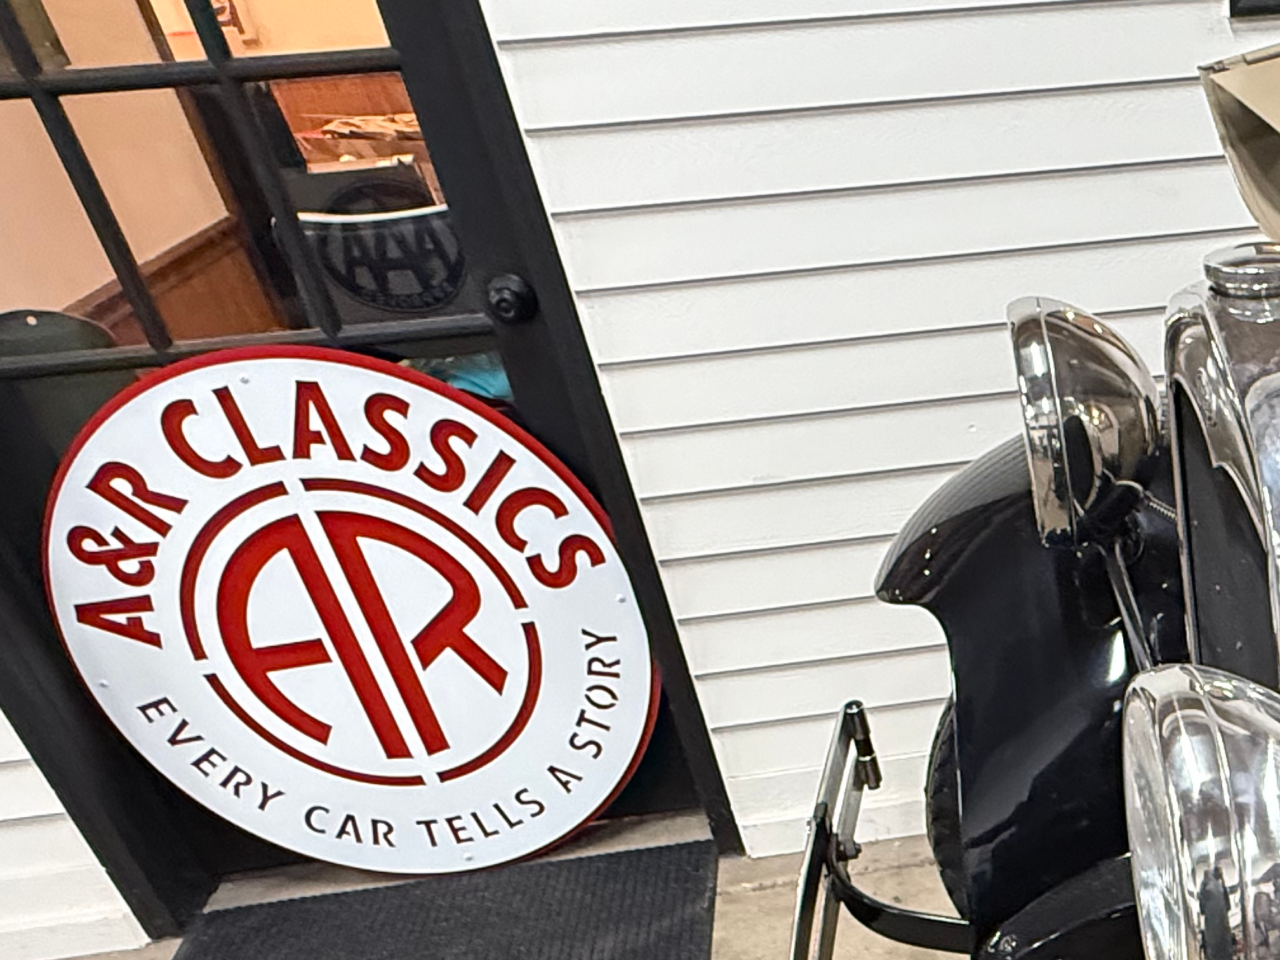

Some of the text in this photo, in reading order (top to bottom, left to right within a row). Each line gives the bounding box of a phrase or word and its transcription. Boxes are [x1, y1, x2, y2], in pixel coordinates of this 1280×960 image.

[67, 380, 607, 649] A&R CLASSICS
[215, 510, 508, 759] AR
[136, 628, 619, 848] EVERY CAR TELLS A STORY
